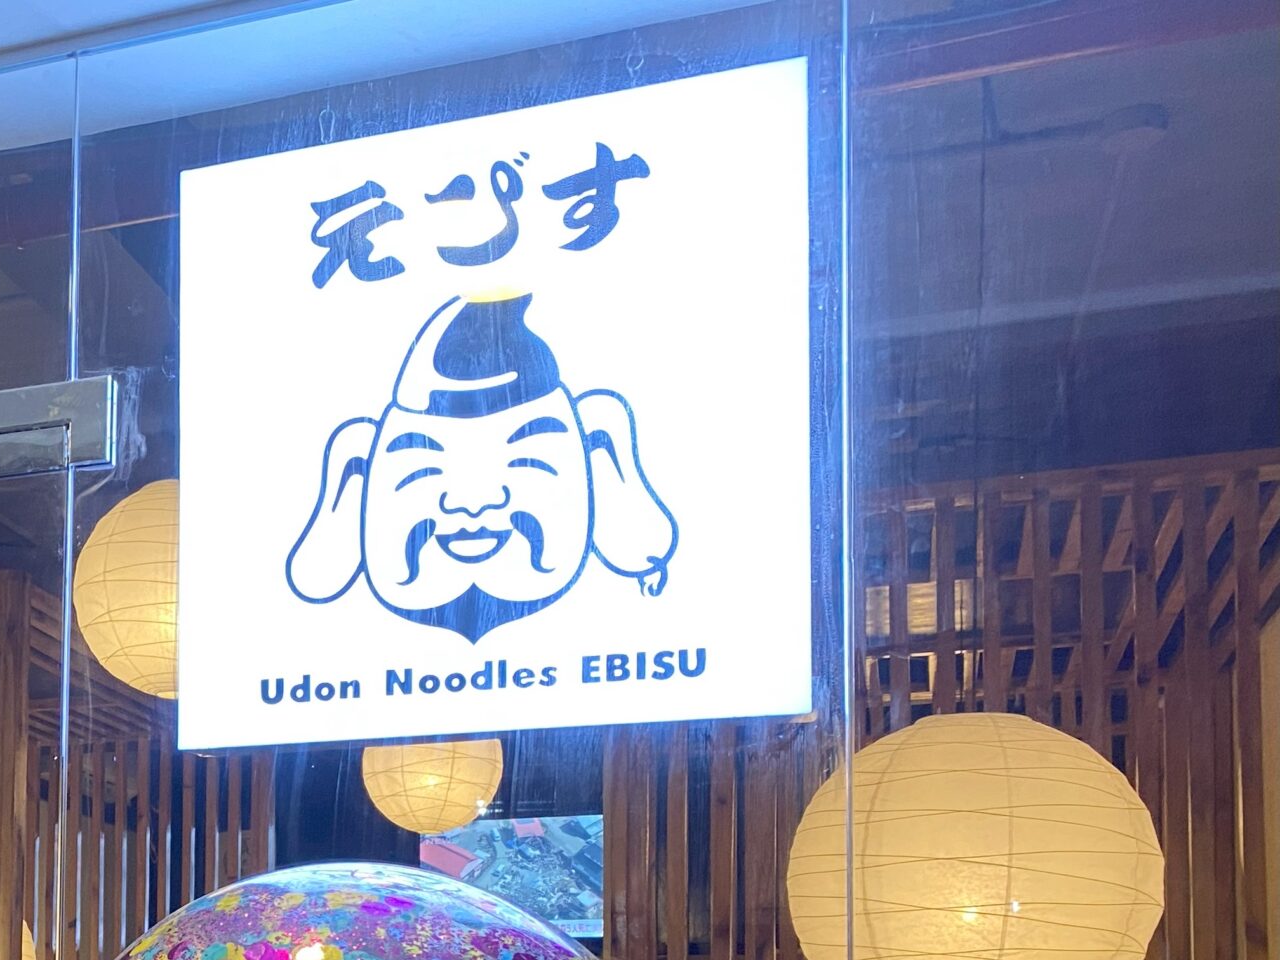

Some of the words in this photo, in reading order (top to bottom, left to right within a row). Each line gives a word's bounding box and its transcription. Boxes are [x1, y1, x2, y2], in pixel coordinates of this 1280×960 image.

[260, 677, 361, 705] Udon
[385, 658, 558, 697] Noodles
[581, 646, 707, 684] EBISU
